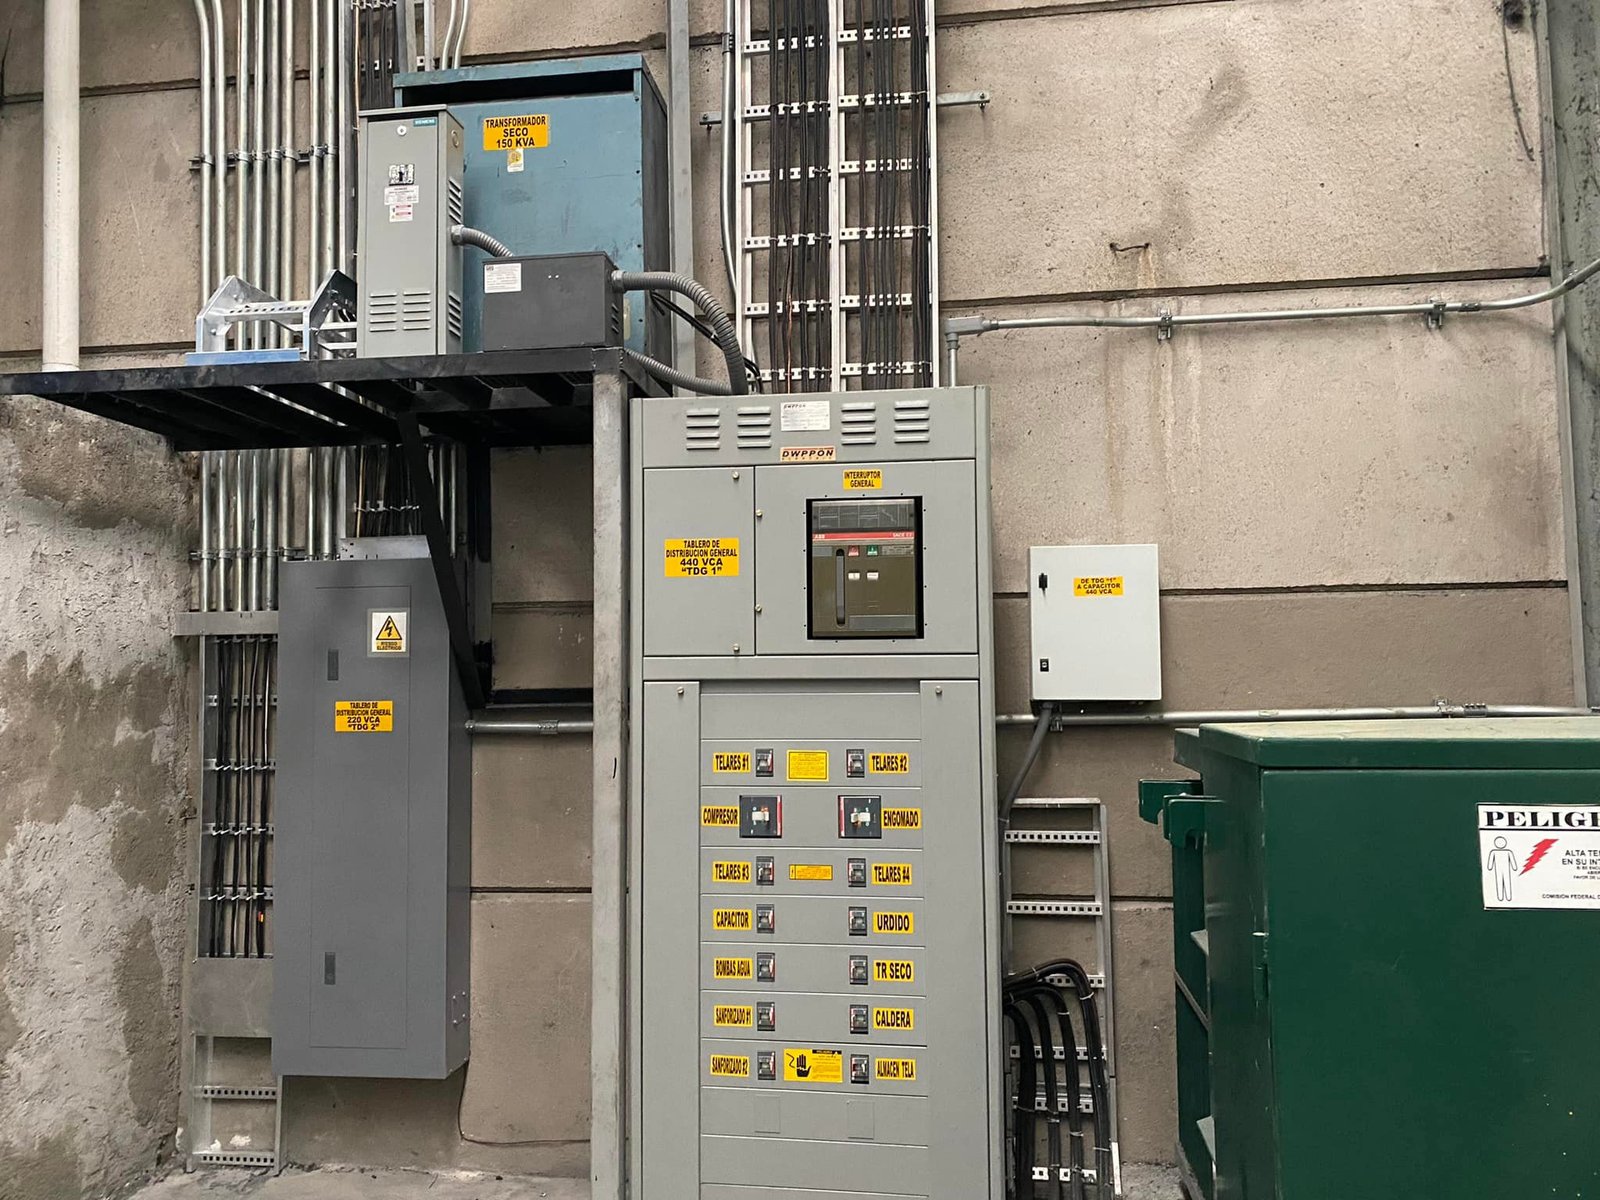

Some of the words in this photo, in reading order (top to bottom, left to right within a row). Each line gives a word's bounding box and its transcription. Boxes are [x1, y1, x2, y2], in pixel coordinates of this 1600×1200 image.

[485, 116, 546, 128] TRANSFORMADOR
[503, 127, 529, 138] SECO
[496, 139, 513, 148] 150
[516, 137, 535, 147] KVA
[844, 470, 881, 479] INTERRUPTOR
[850, 479, 875, 488] GENERAL
[684, 540, 711, 548] TABLERO
[712, 539, 720, 548] DE
[665, 549, 708, 558] DISTRIBUCION
[709, 548, 737, 557] GENERAL
[680, 558, 699, 566] 440
[701, 557, 723, 566] VCA
[715, 755, 741, 771] TELARES
[742, 755, 749, 771] #1
[872, 756, 899, 771] TELARES
[900, 756, 908, 771] #2
[703, 807, 738, 824] COMPRESOR
[883, 810, 919, 827] ENGOMADO
[1565, 849, 1586, 857] ALTA
[1587, 849, 1600, 857] TE
[1561, 858, 1573, 866] EN
[1575, 858, 1587, 866] SU
[715, 864, 741, 880] TELARES
[742, 864, 749, 880] #3
[874, 866, 902, 882] TELARES
[902, 866, 910, 882] #4
[716, 911, 749, 928] CAPACITOR
[876, 914, 910, 931] URDIDO
[715, 960, 736, 977] BOMBAS
[737, 960, 751, 977] AGUA
[875, 962, 887, 979] TR
[889, 962, 912, 979] SECO
[715, 1007, 745, 1024] SANFORIZADO
[875, 1010, 911, 1028] CALDERA
[711, 1056, 743, 1074] SANFORIZADO
[876, 1060, 900, 1077] ALMACEN
[901, 1060, 914, 1078] TELA
